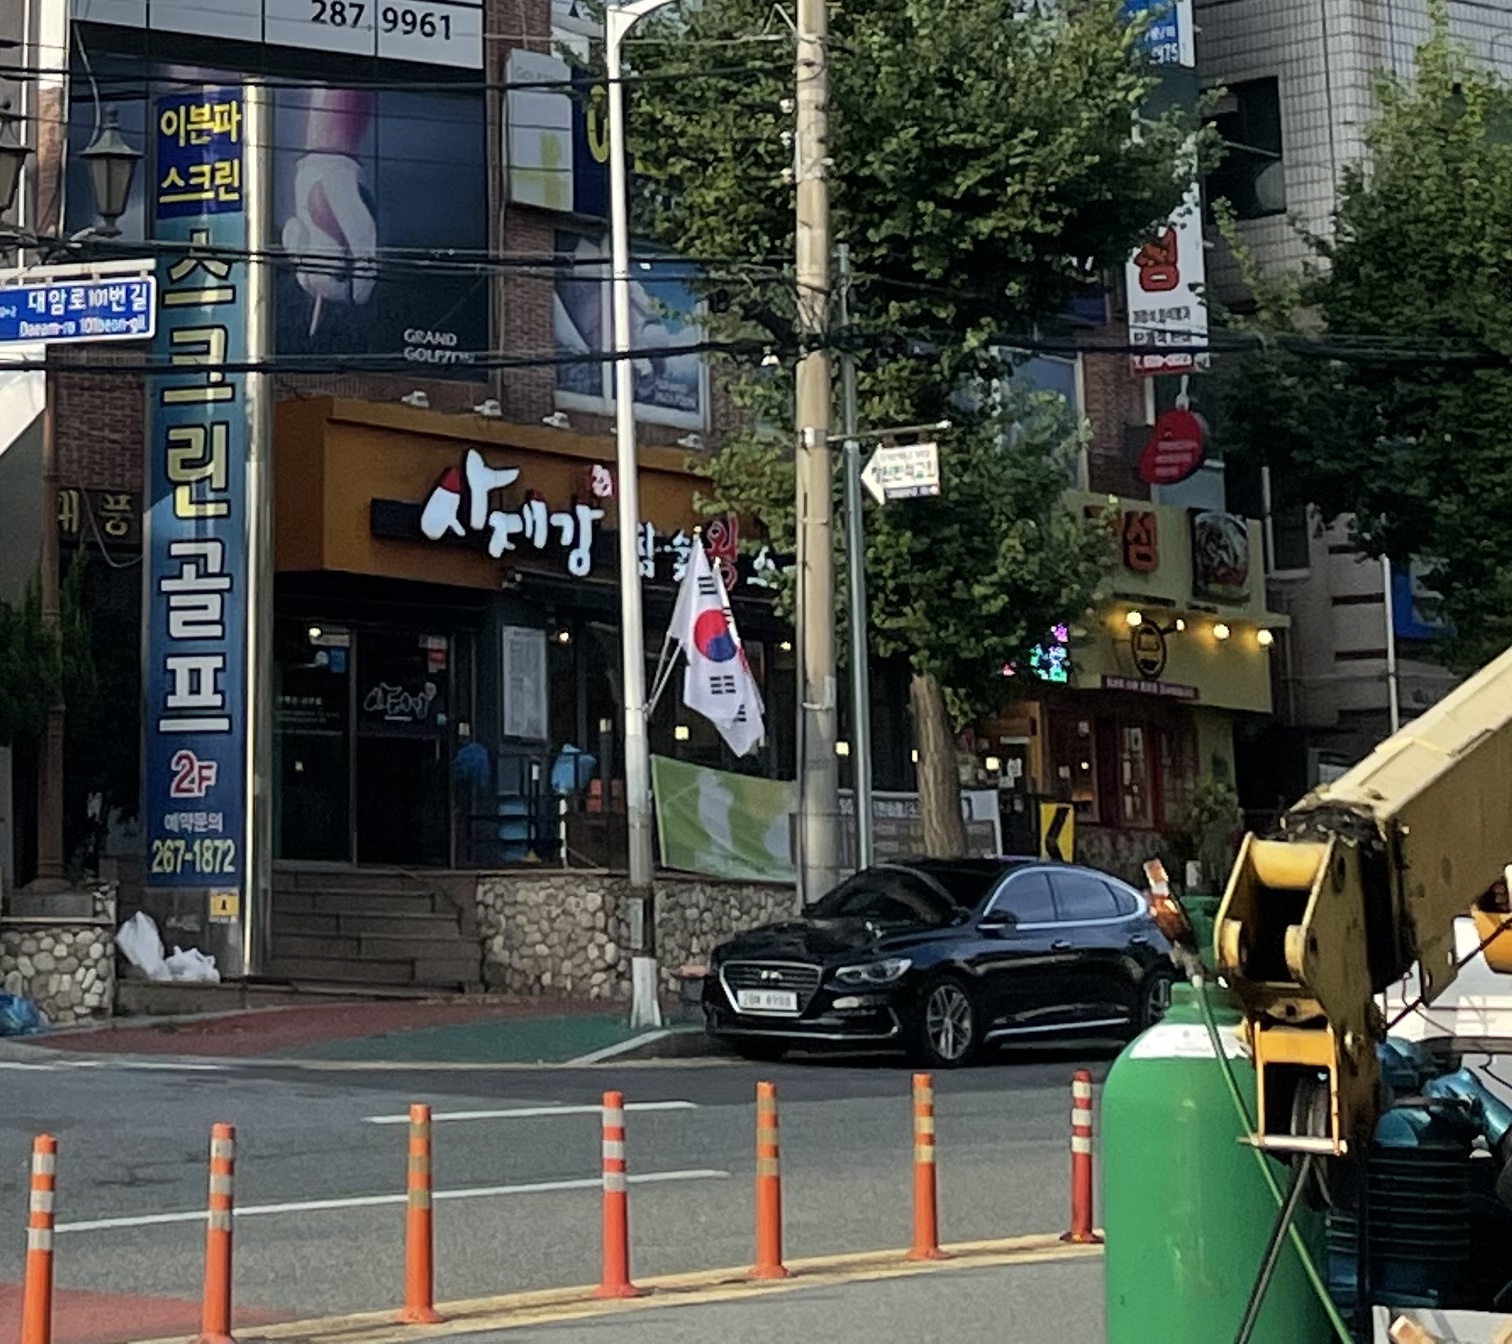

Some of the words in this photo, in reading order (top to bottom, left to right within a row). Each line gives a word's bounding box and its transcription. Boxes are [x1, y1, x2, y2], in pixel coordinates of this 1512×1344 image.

[160, 102, 241, 148] 이븐파
[159, 159, 240, 204] 스크린
[27, 283, 148, 317] 대암로101번길
[160, 228, 236, 734] 스크린골프
[170, 749, 218, 799] 2F
[164, 811, 224, 833] 예약문의
[151, 839, 236, 875] 267-1872
